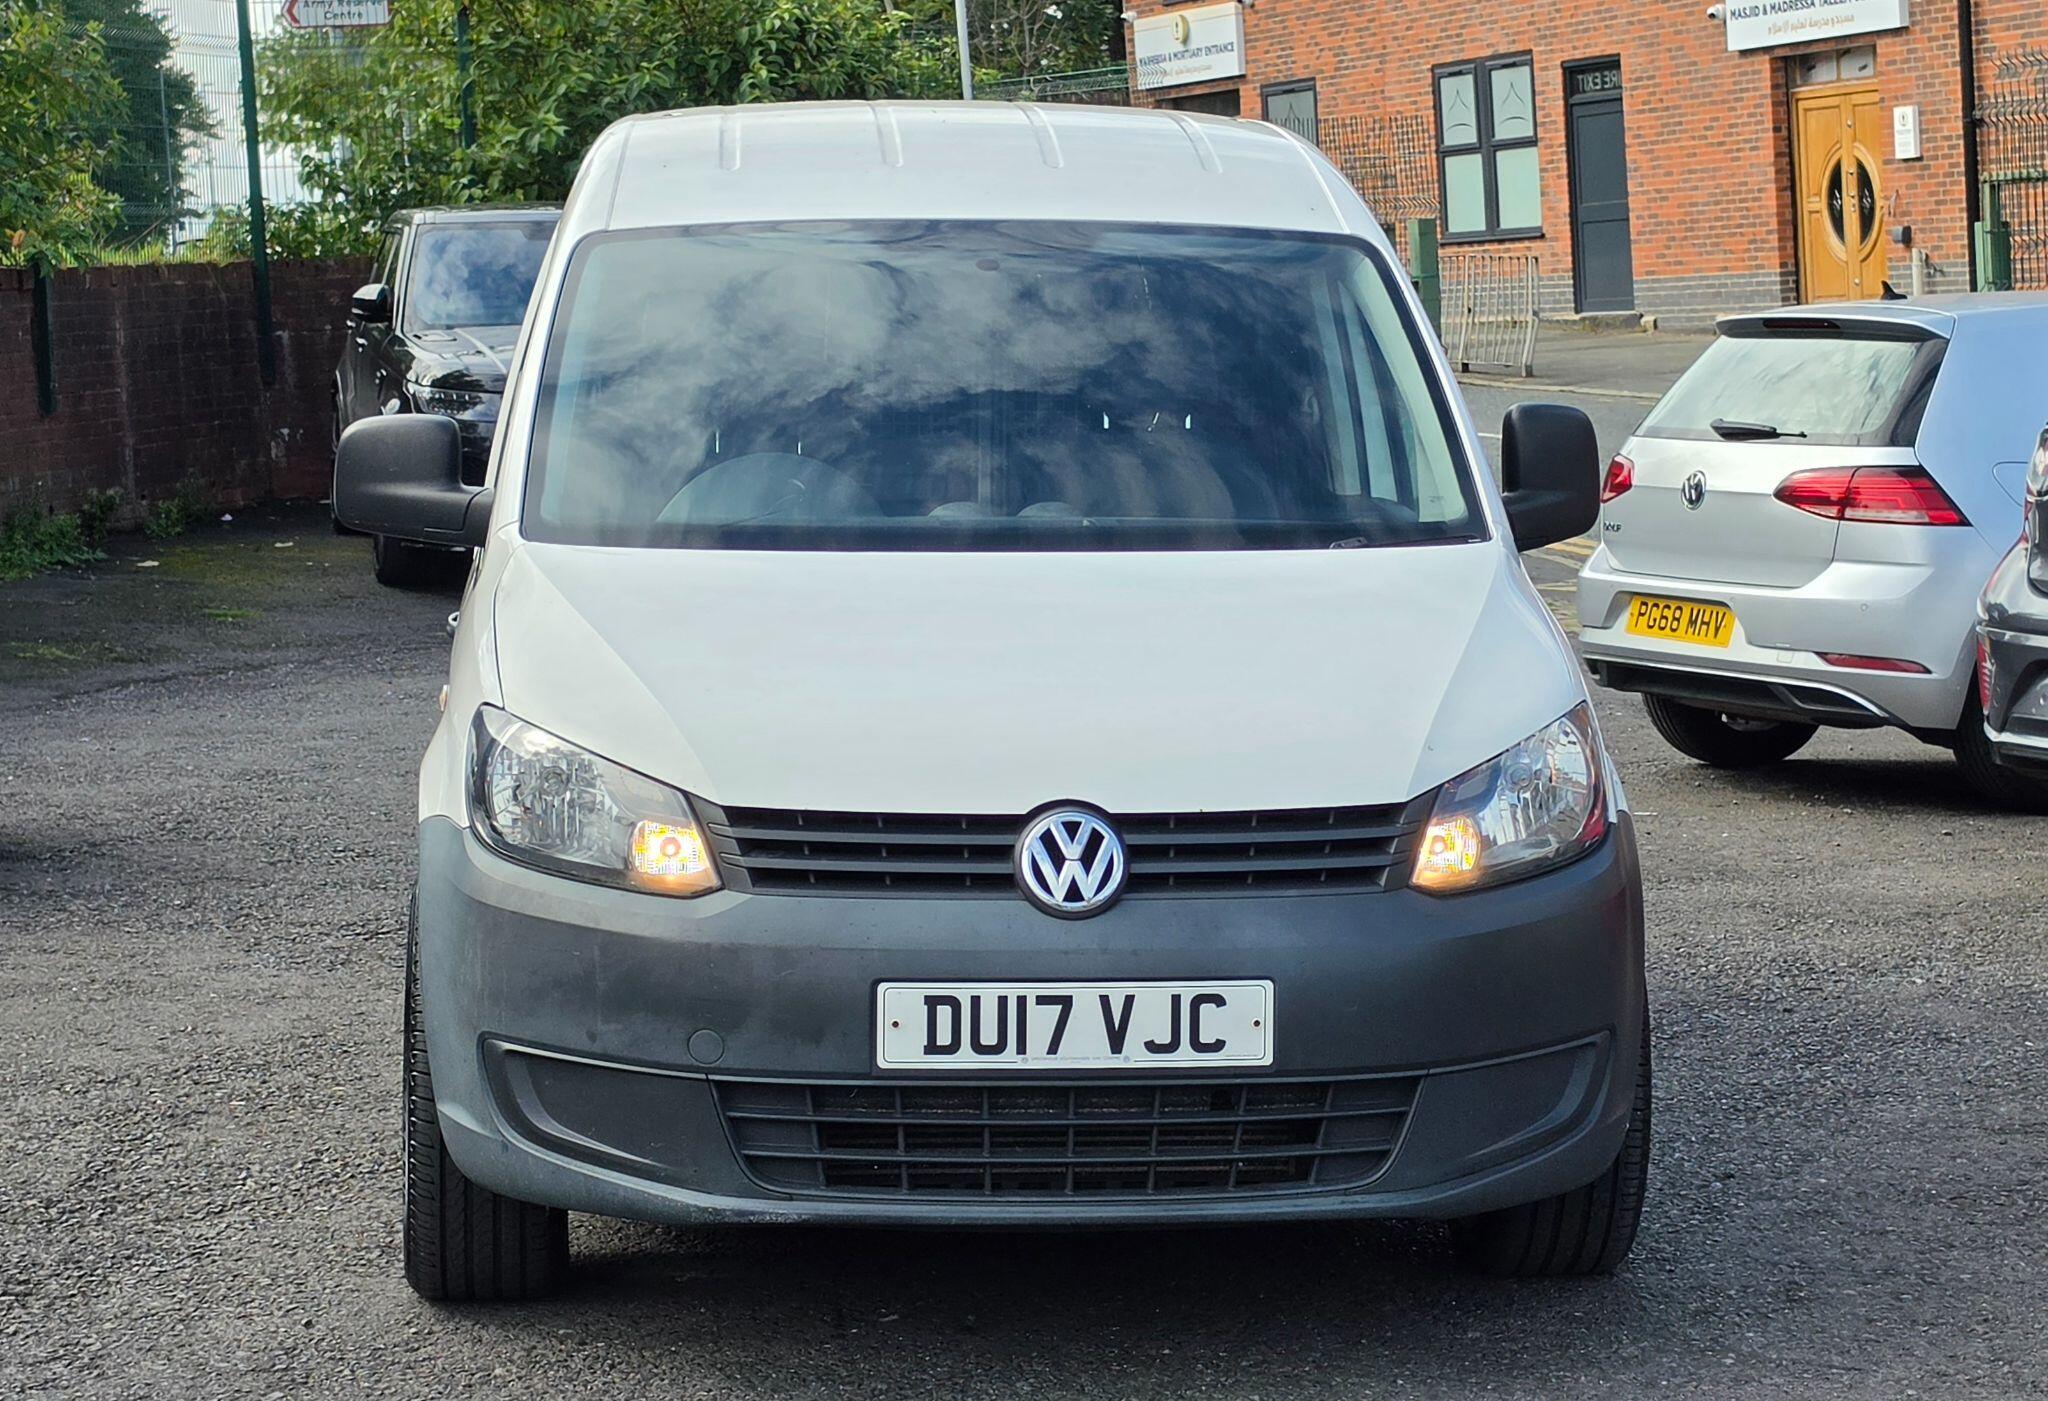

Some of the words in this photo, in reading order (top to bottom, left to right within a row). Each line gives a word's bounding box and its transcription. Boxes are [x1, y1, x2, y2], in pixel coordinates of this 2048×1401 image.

[324, 10, 364, 21] Centre
[1730, 6, 1760, 21] MASJID
[1770, 0, 1816, 15] MADRESSA
[1173, 47, 1203, 61] MORTUARY
[1204, 41, 1235, 57] ENTRANCE
[1635, 600, 1684, 633] PG68
[1685, 606, 1727, 640] MHV
[923, 994, 1074, 1055] DU17
[1099, 993, 1227, 1055] VJC
